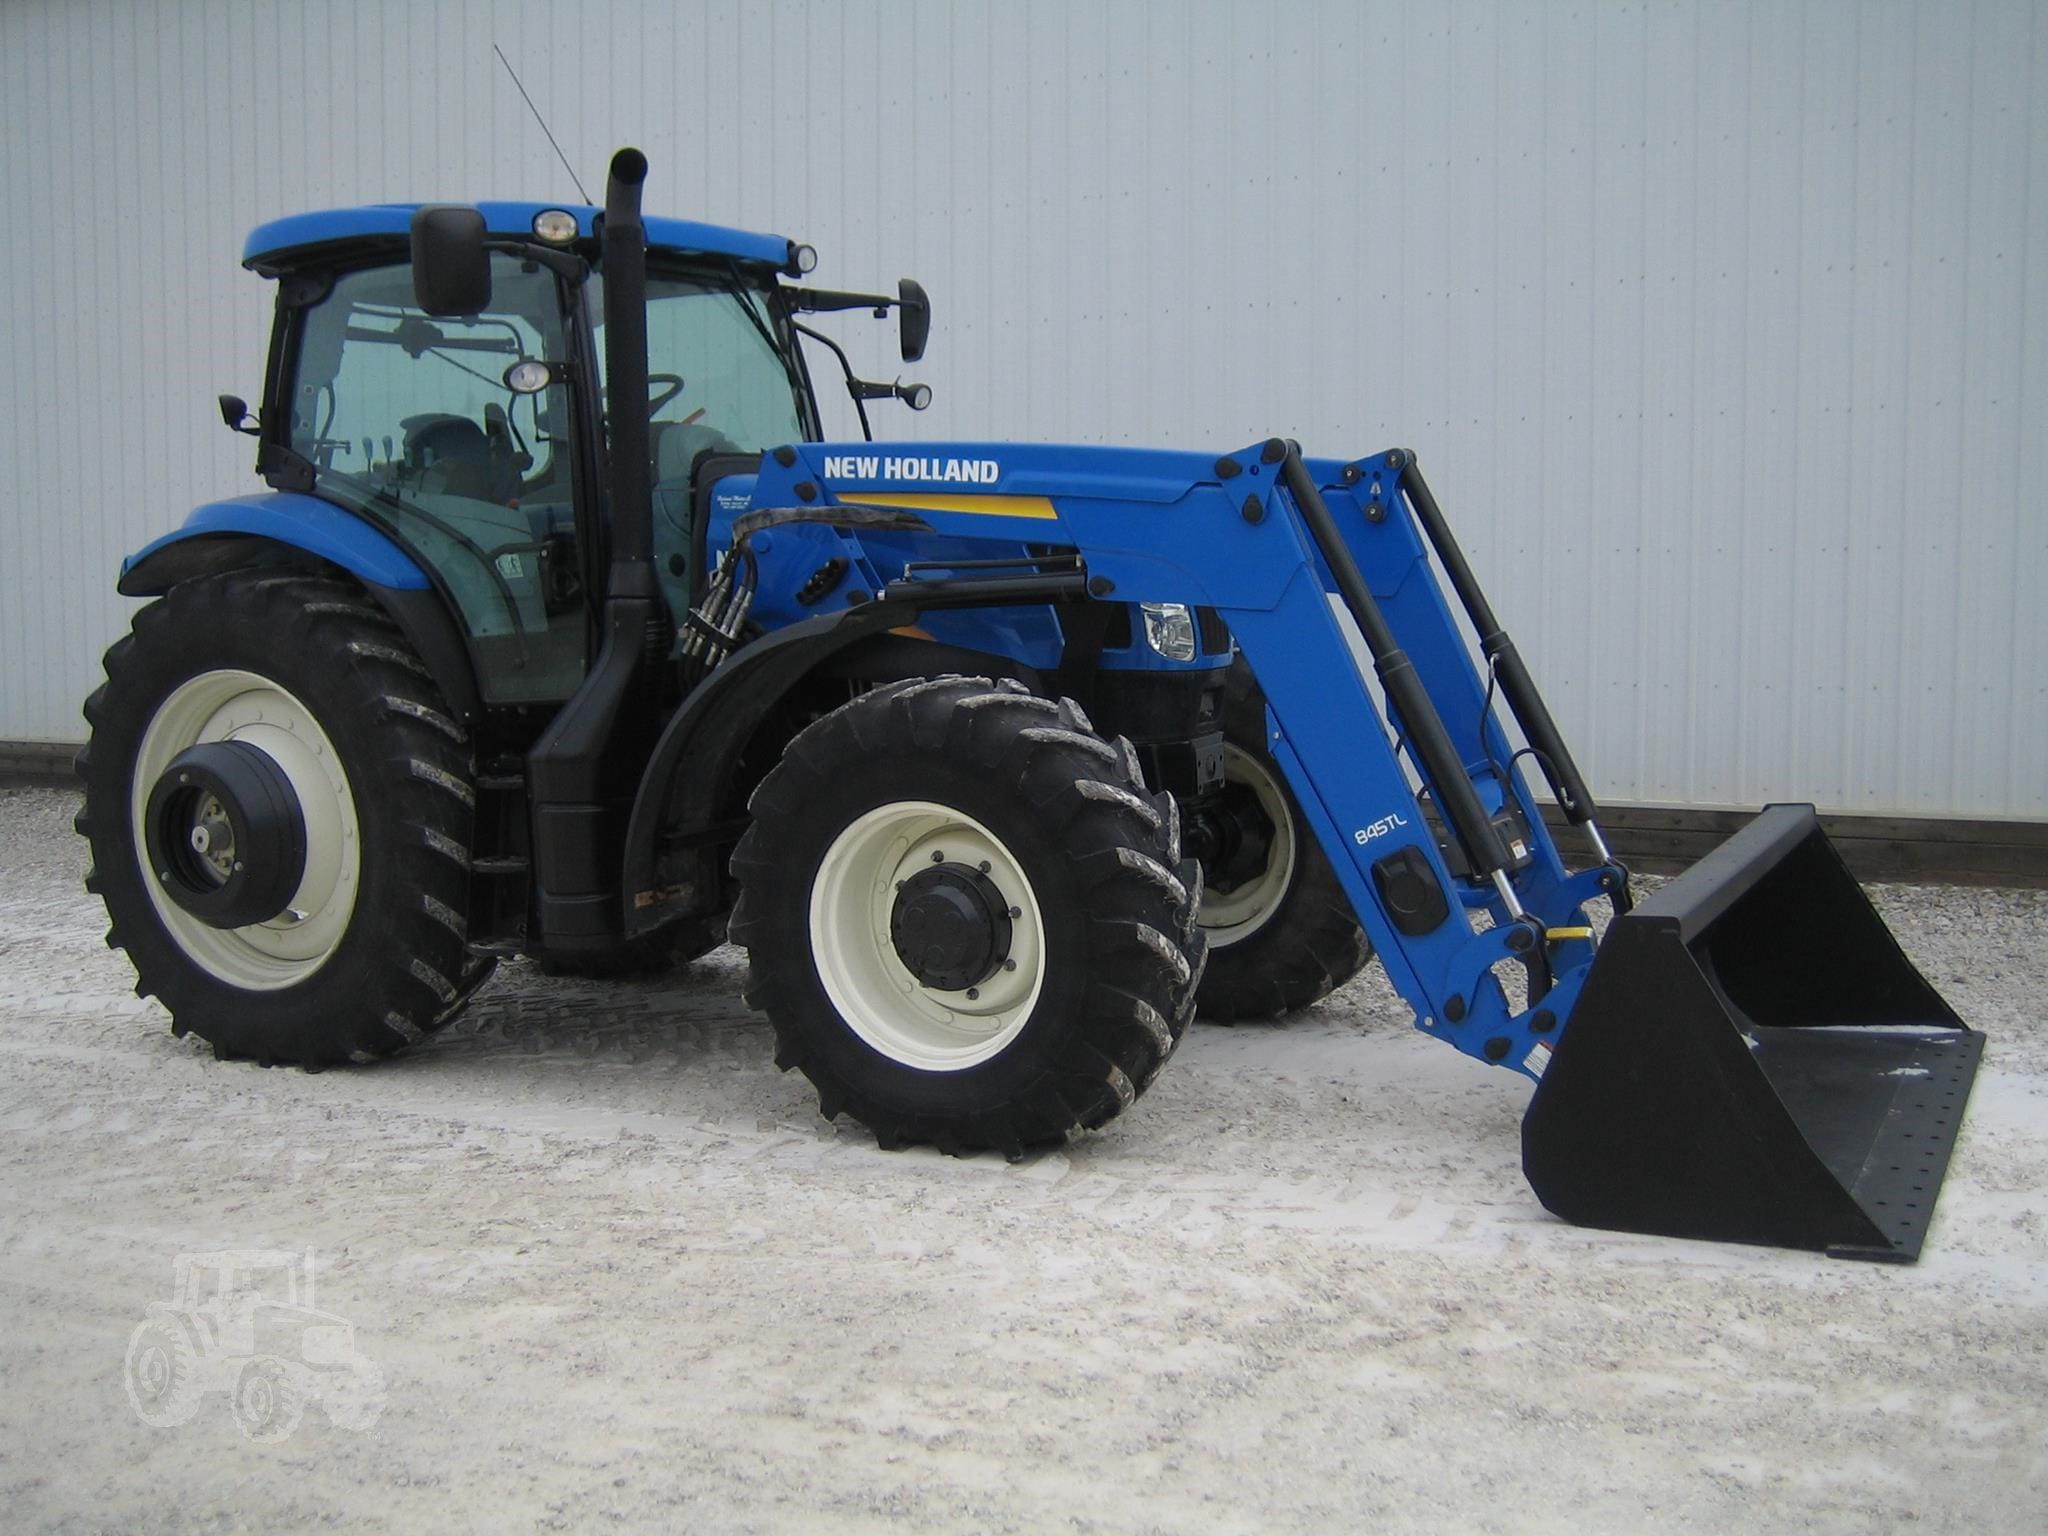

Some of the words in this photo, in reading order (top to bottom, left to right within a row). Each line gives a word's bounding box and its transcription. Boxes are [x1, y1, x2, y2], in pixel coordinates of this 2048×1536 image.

[824, 456, 879, 479] NEW
[884, 457, 999, 483] HOLLAND
[1354, 813, 1408, 845] 845TL
